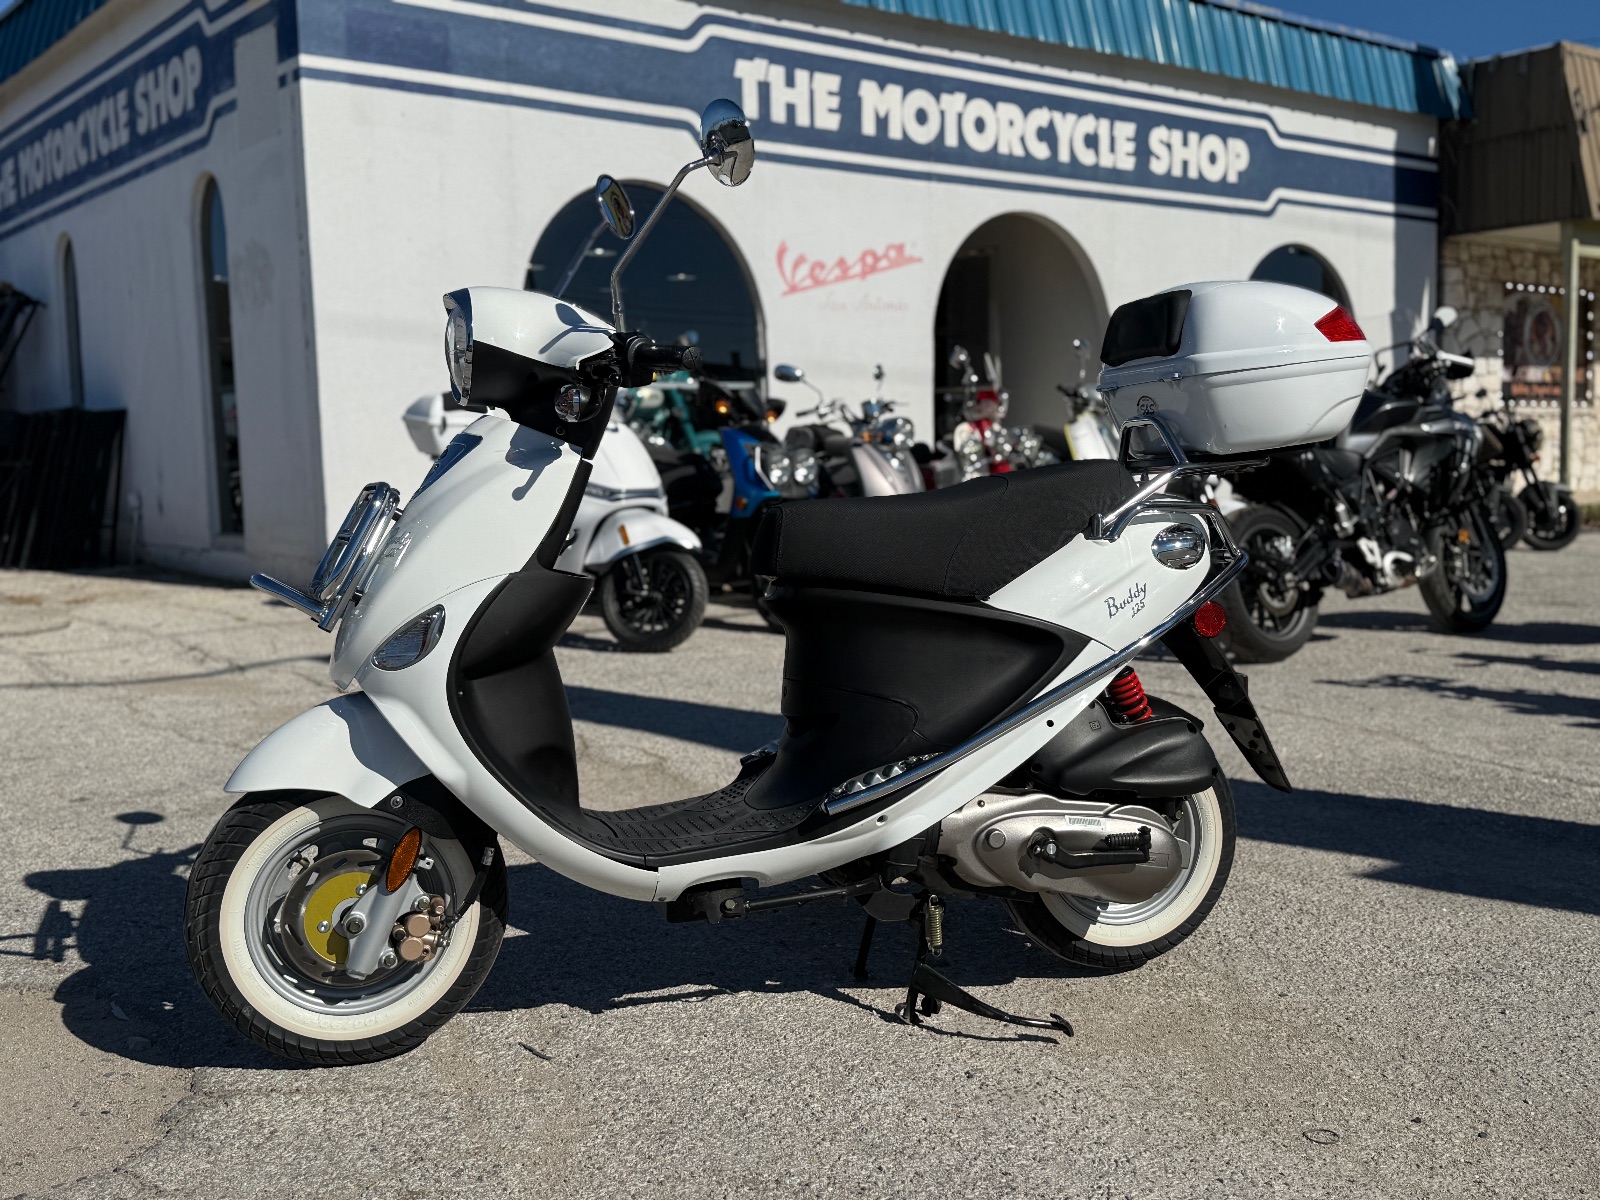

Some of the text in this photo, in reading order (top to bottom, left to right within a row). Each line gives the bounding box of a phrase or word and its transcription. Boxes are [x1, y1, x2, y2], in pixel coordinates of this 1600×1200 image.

[18, 88, 131, 198] MOTORCYCLE
[134, 45, 202, 136] SHOP
[734, 58, 1250, 184] THE MOTORCYCLE SHOP
[776, 240, 923, 297] Vespa
[1104, 583, 1147, 619] Buddy
[1131, 600, 1146, 618] 125
